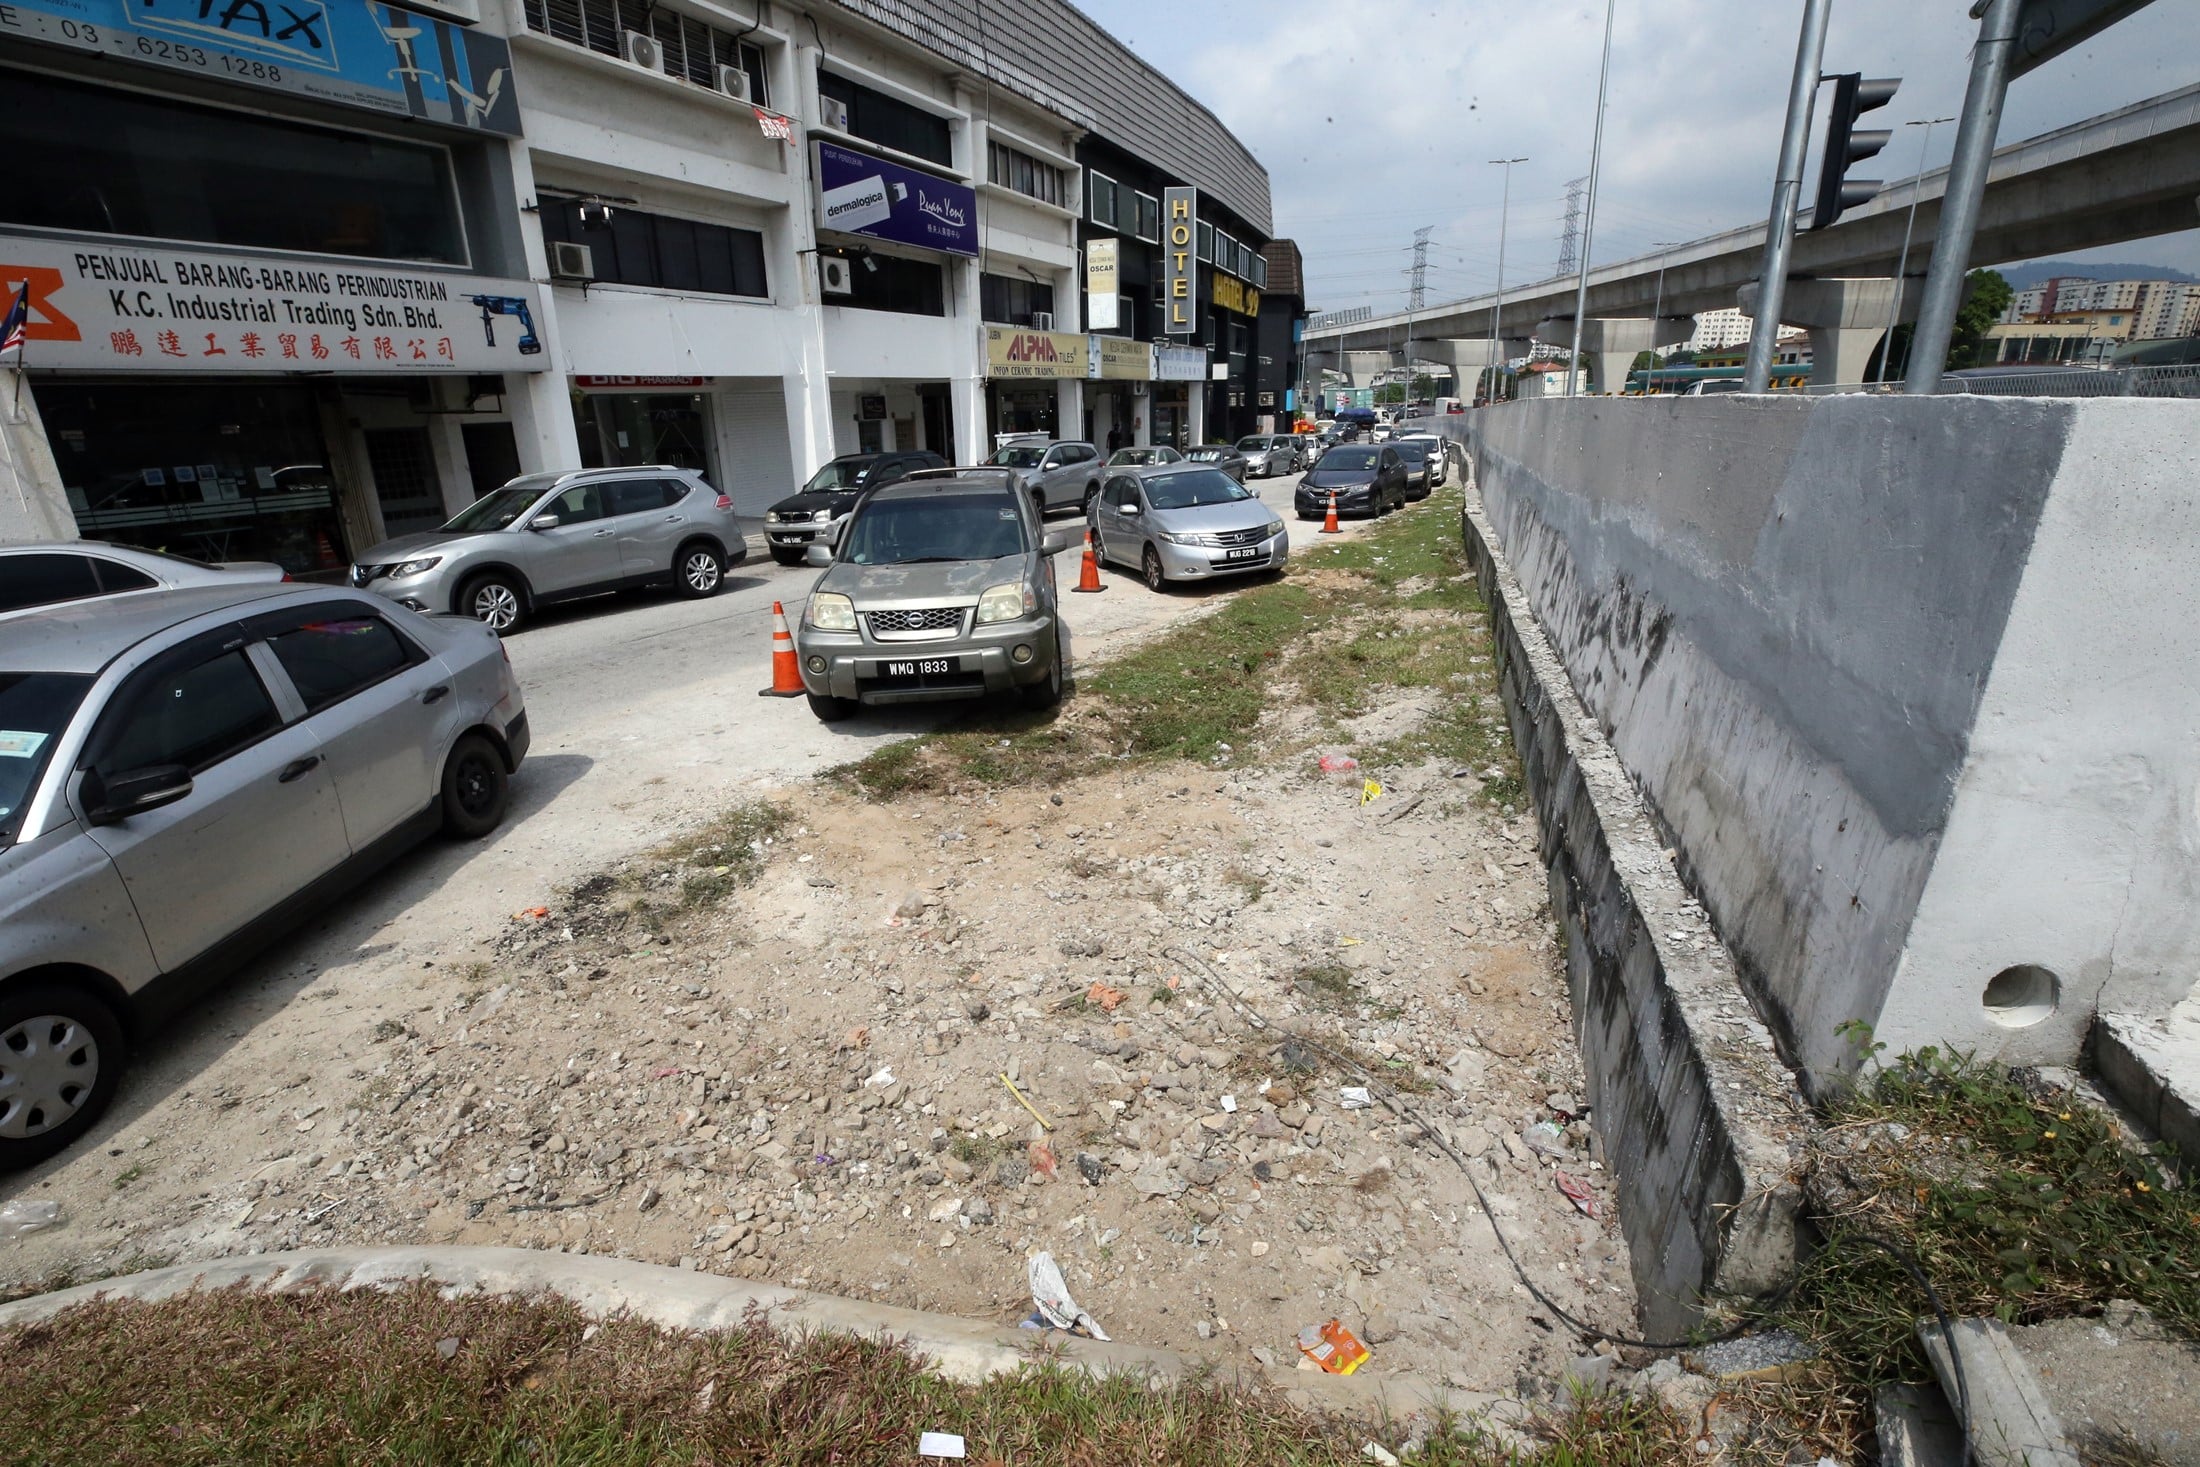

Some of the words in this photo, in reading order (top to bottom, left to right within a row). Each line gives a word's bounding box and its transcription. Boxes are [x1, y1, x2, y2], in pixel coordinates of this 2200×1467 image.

[61, 20, 98, 43] 03
[137, 36, 207, 66] 6253
[221, 55, 281, 82] 1288
[827, 191, 884, 217] dermalogica
[75, 253, 168, 284] PENJUAL
[175, 261, 330, 295] BARANG-BARANG
[336, 274, 448, 301] PERINDUSTRIAN
[1090, 265, 1114, 273] OSCAR
[1171, 199, 1190, 323] HOTEL
[109, 289, 163, 318] K.C.
[167, 292, 277, 323] Industrial
[282, 300, 357, 332] Trading
[362, 304, 402, 327] Sdn.
[403, 306, 442, 329] Bhd.
[1007, 334, 1058, 362] ALPHA
[889, 662, 915, 676] WMQ
[919, 660, 948, 673] 1833
